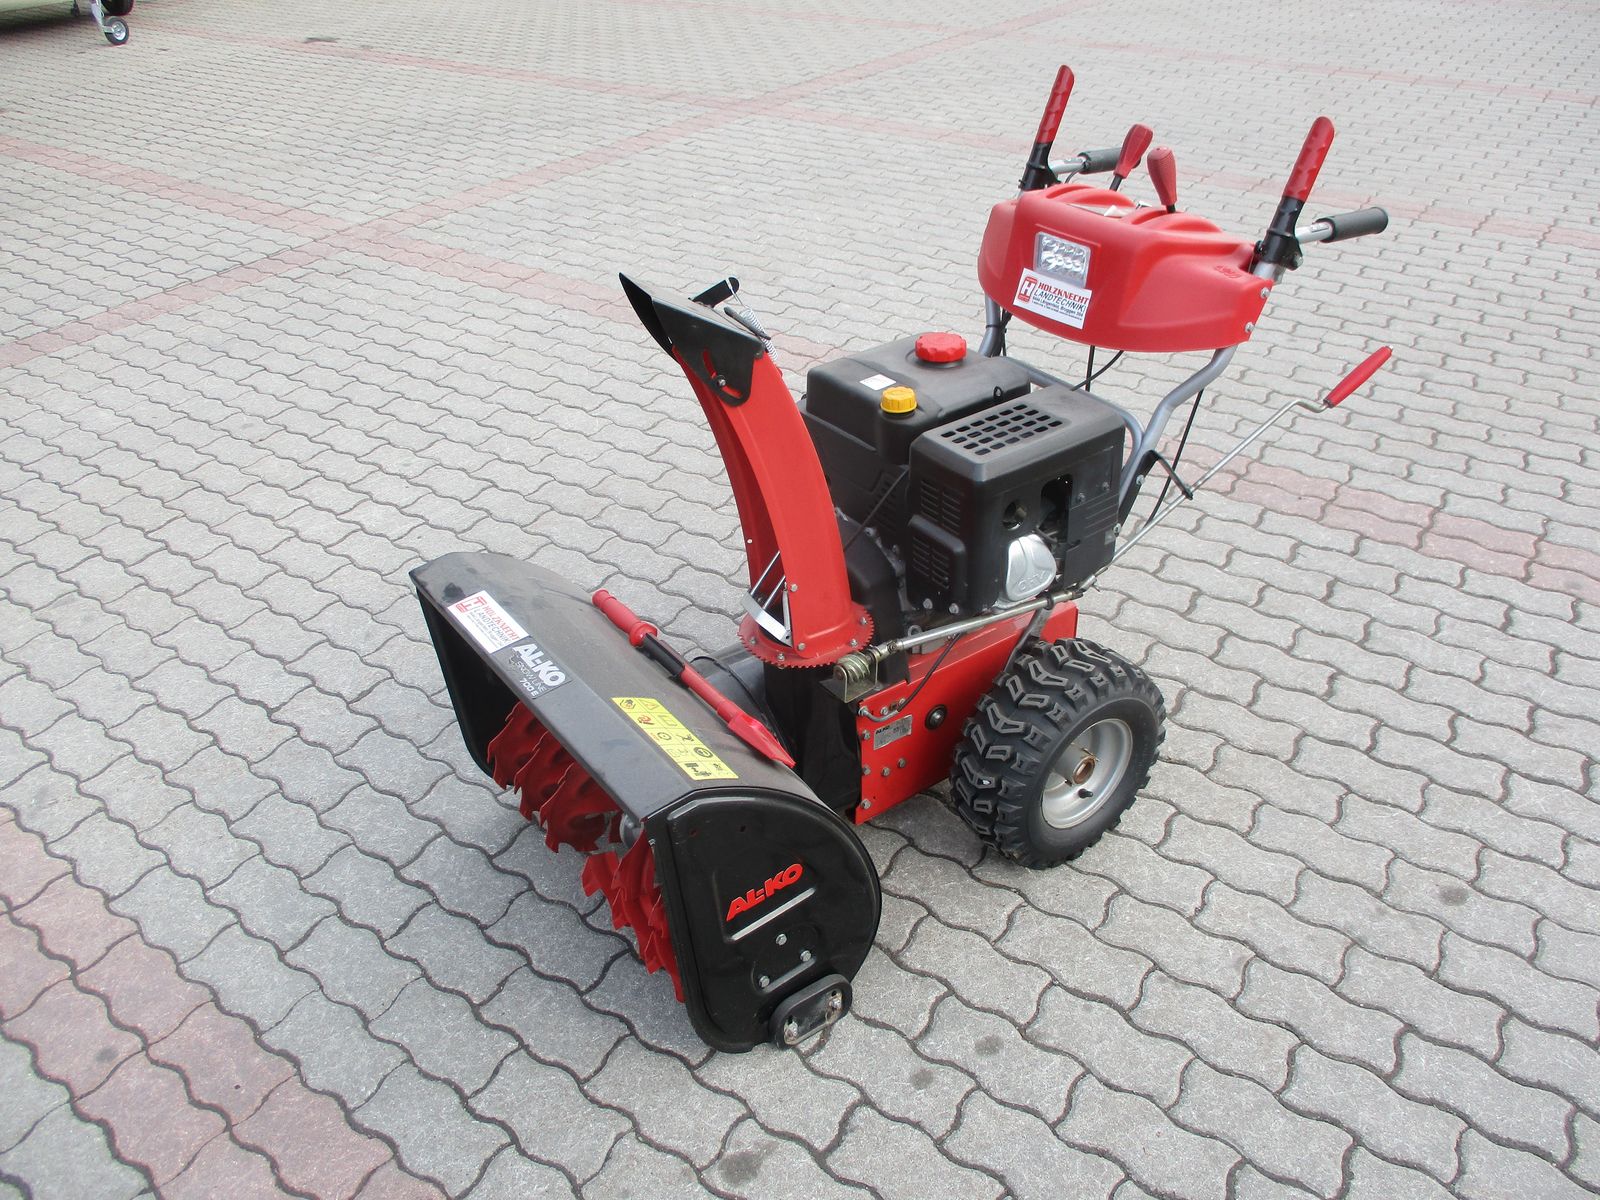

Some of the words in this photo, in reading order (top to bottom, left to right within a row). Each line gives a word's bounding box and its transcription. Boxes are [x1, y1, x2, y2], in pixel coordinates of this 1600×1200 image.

[1034, 289, 1084, 312] LANDTECHNIK
[1037, 282, 1089, 305] HOLZKNECHT
[473, 608, 512, 643] LANDTECHNIK
[482, 604, 520, 641] HOLZKNECHT
[512, 643, 566, 687] AL-KO
[520, 678, 534, 692] 700
[725, 863, 804, 922] AL-KO
